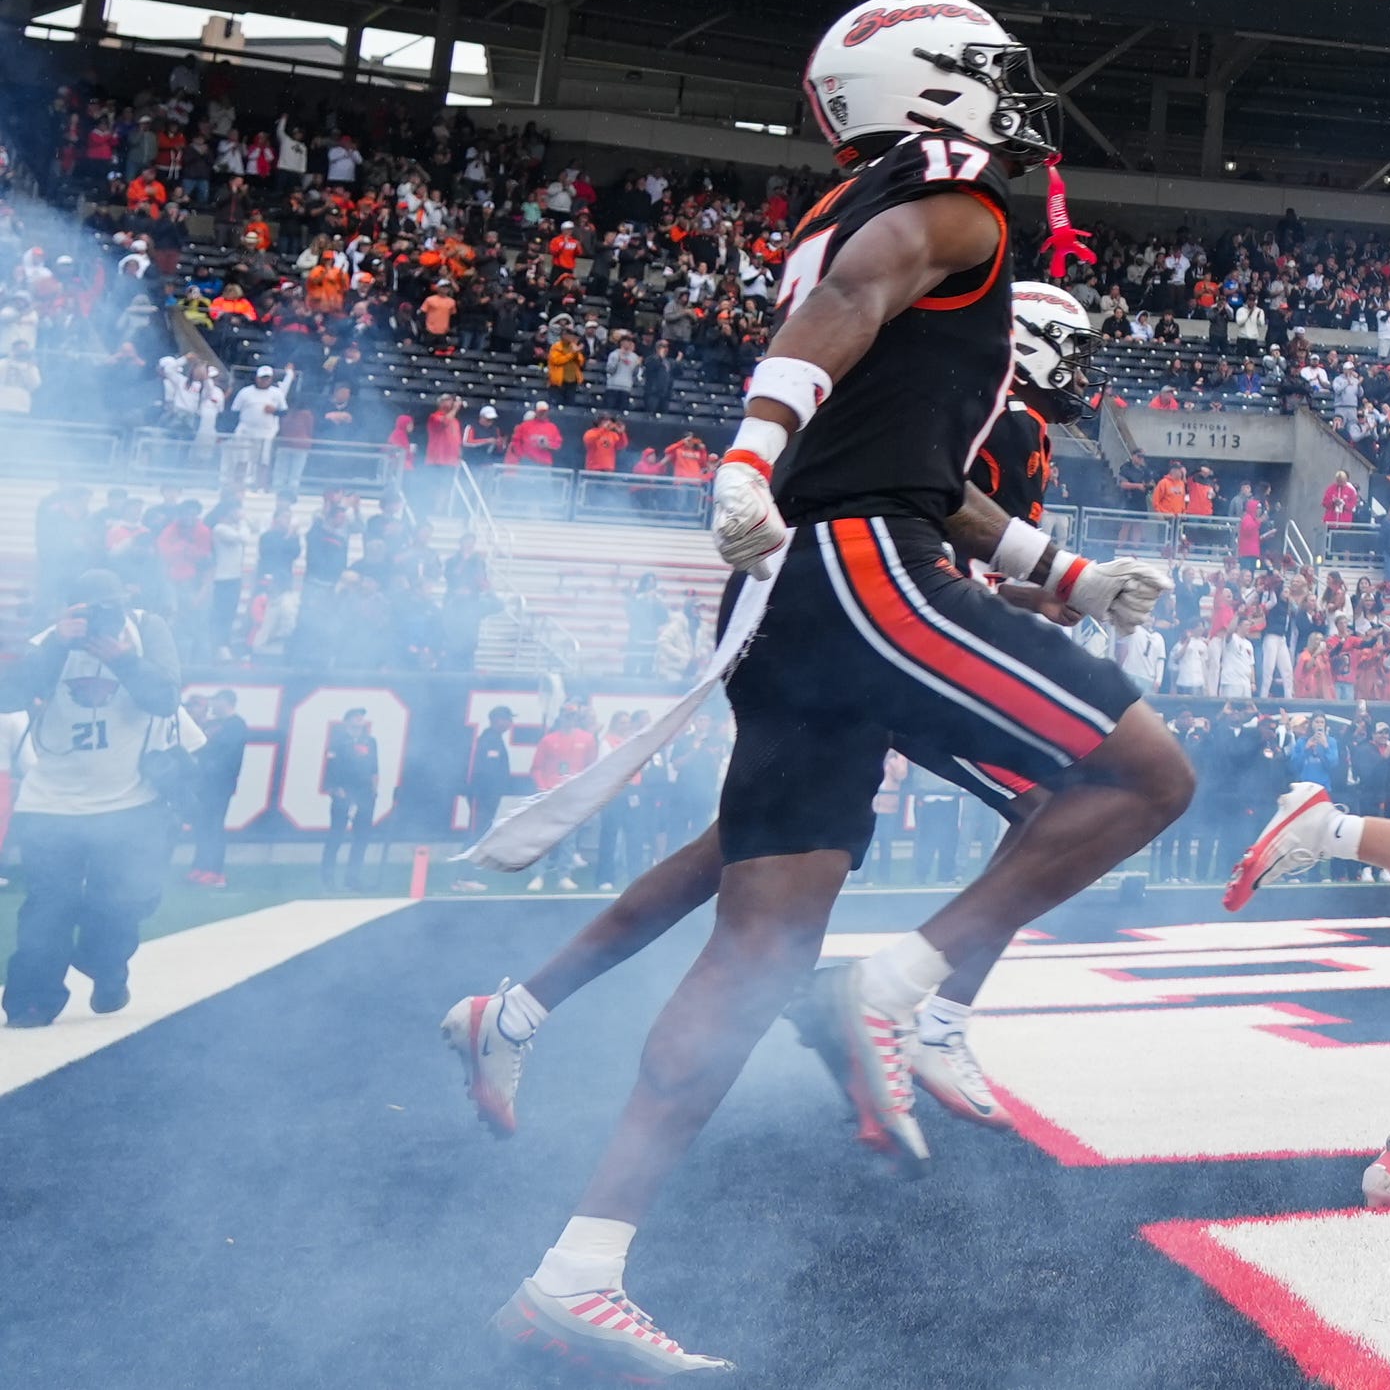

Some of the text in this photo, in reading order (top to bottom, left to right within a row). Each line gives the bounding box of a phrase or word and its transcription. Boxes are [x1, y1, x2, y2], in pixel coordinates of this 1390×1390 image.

[921, 138, 991, 182] 17
[1182, 422, 1227, 431] SECTIONS
[1166, 432, 1241, 449] 112 113
[71, 720, 109, 751] 21
